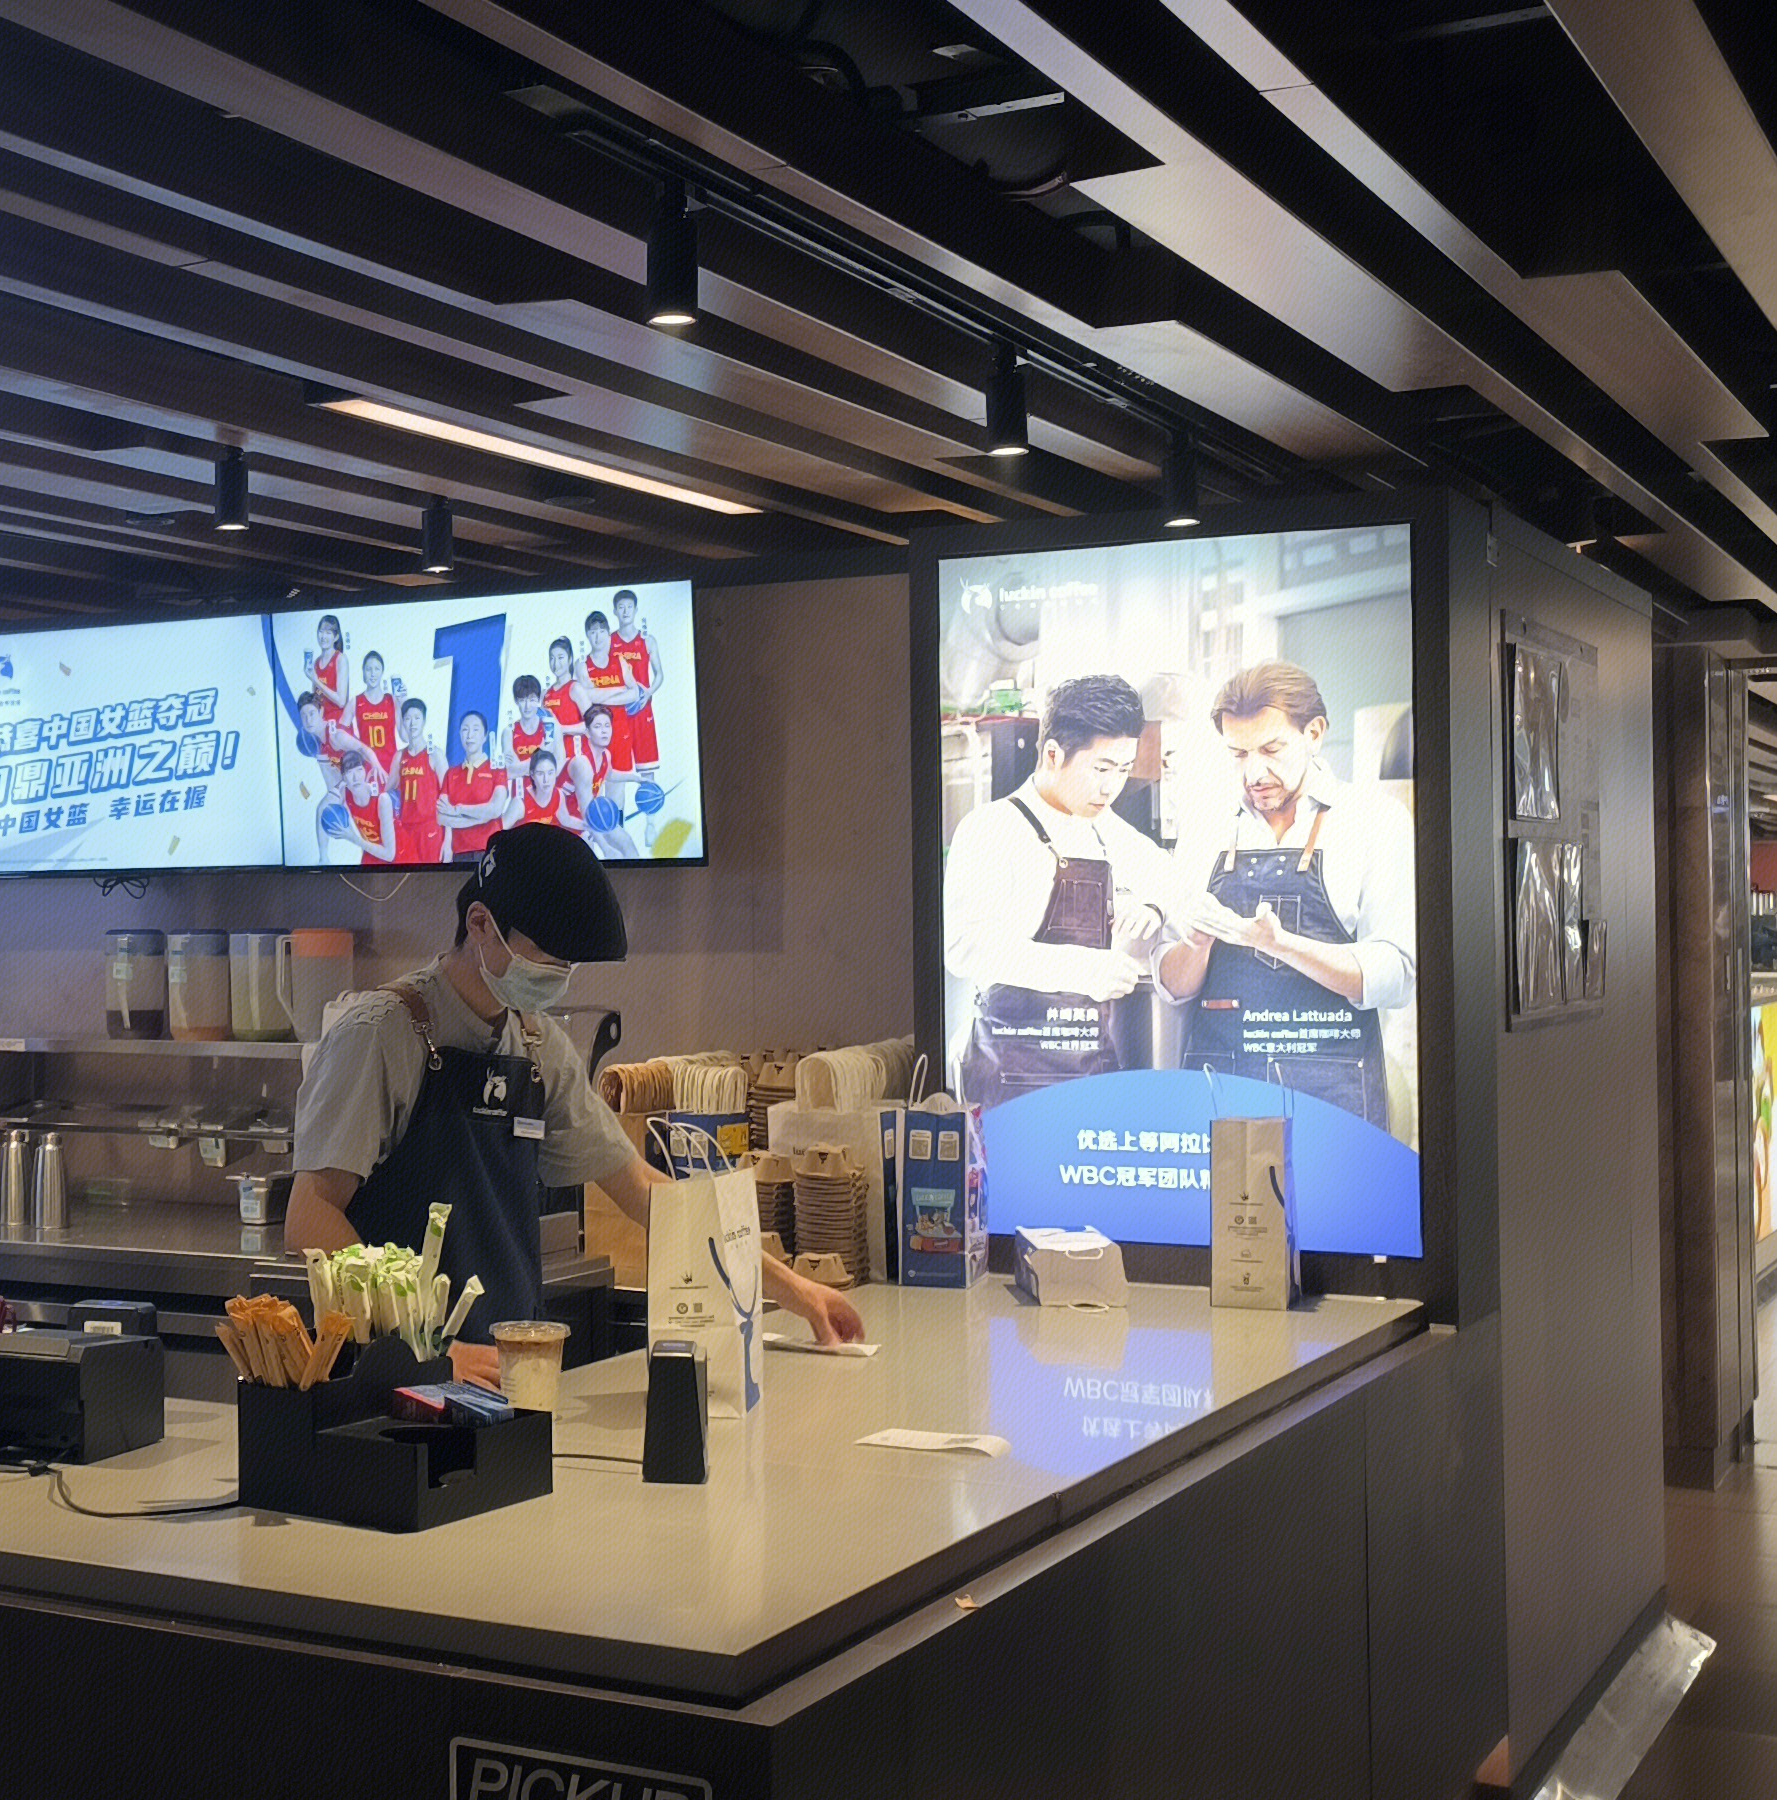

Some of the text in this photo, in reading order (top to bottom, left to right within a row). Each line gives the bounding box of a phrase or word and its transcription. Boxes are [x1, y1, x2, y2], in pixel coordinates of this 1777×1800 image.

[108, 783, 209, 821] 幸运在握
[1243, 1008, 1353, 1022] Andrea Lattuada
[469, 1757, 691, 1800] PIC
